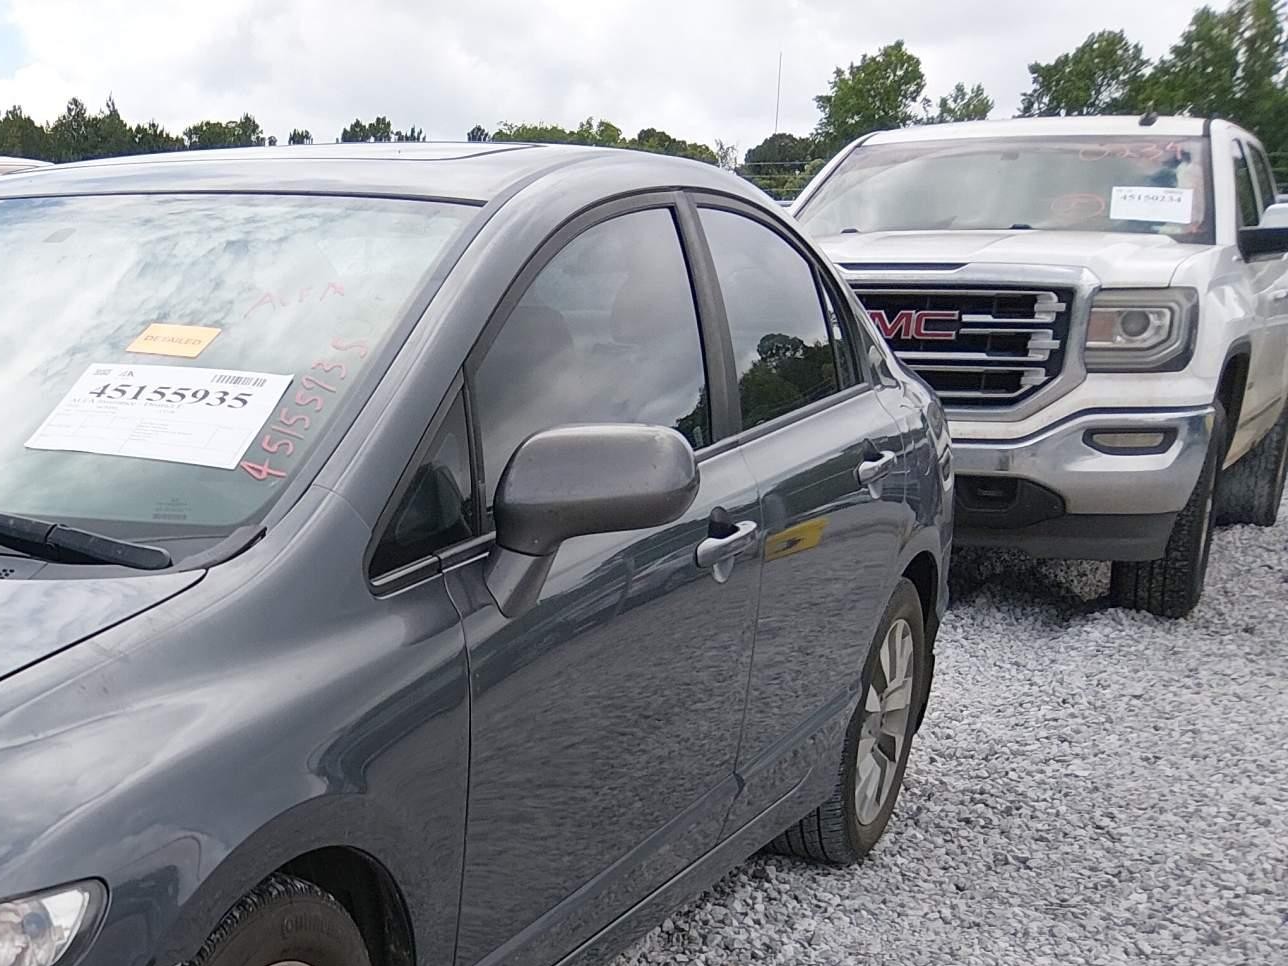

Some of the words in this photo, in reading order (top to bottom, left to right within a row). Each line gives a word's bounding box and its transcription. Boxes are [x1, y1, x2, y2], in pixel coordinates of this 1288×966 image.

[866, 309, 960, 340] MC
[143, 334, 202, 345] DETAILED
[89, 383, 254, 409] 45155935
